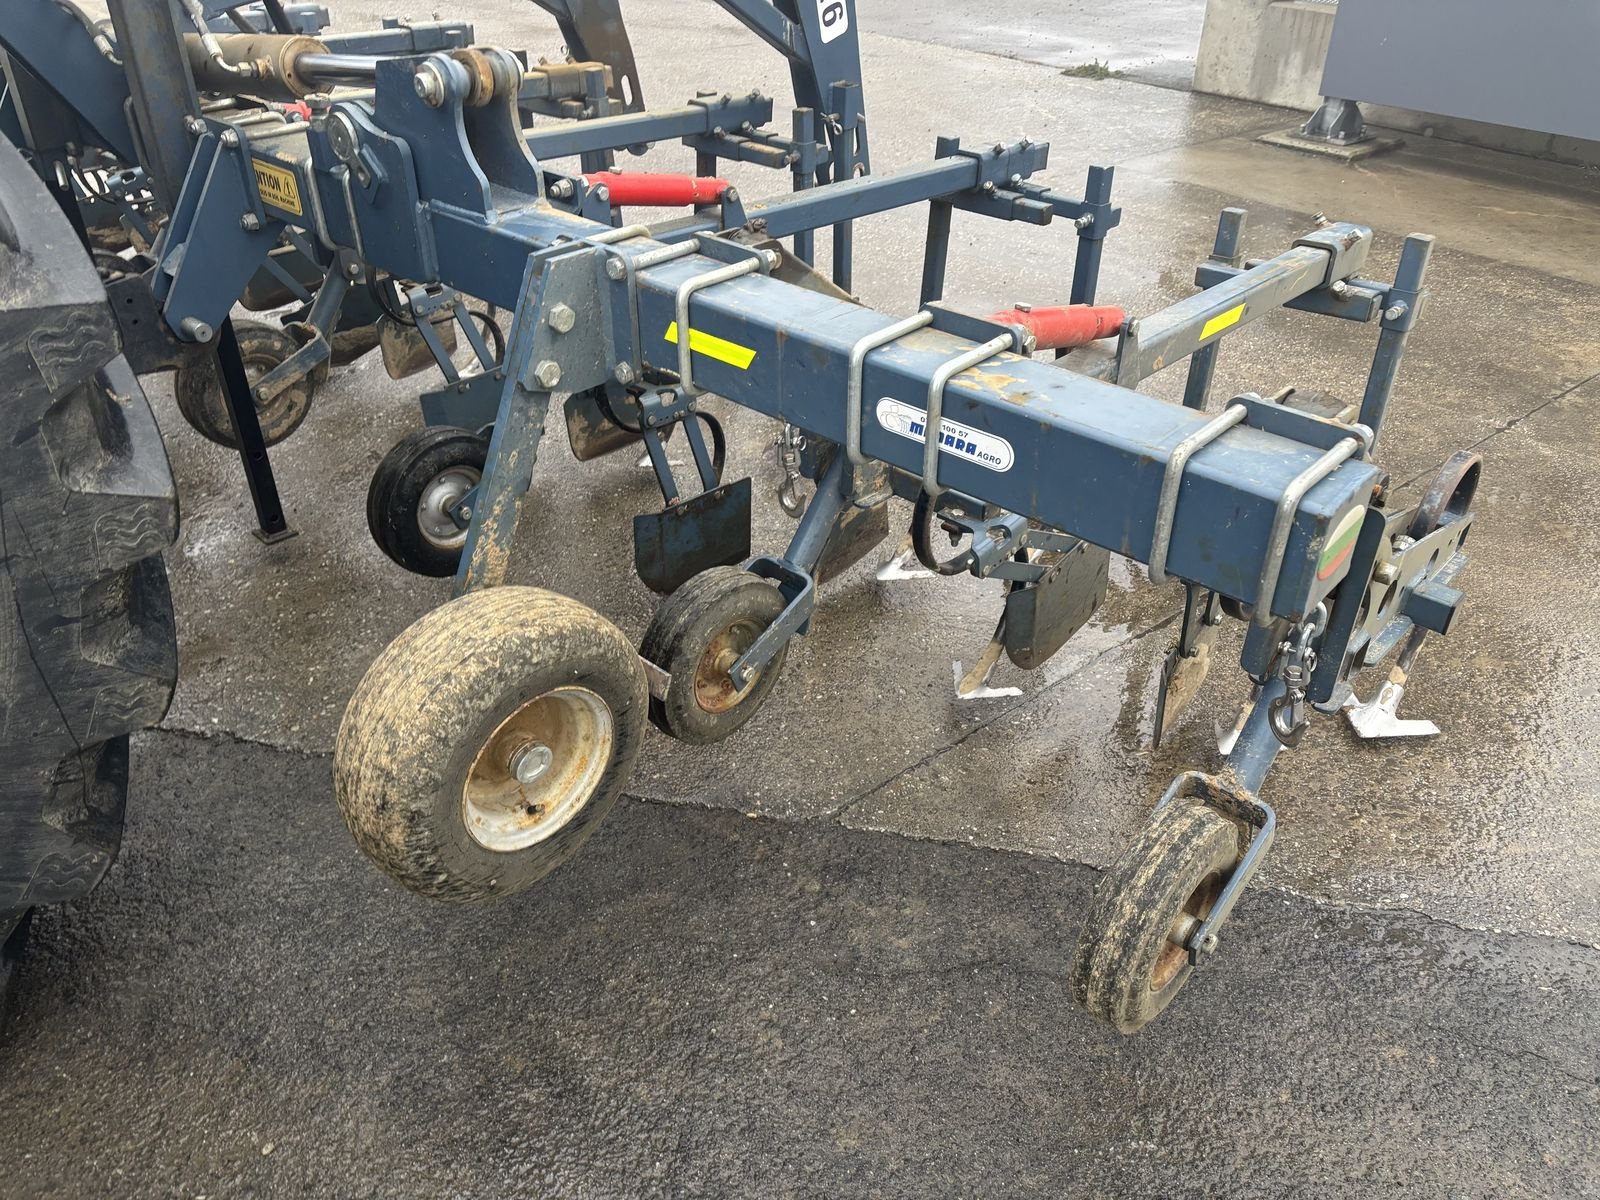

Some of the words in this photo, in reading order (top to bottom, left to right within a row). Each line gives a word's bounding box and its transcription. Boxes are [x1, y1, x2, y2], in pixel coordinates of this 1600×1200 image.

[820, 0, 843, 27] 6
[255, 170, 281, 192] NTION
[910, 421, 977, 455] MARA
[977, 451, 1001, 465] AGRO
[942, 424, 956, 434] 100
[958, 430, 968, 438] 57
